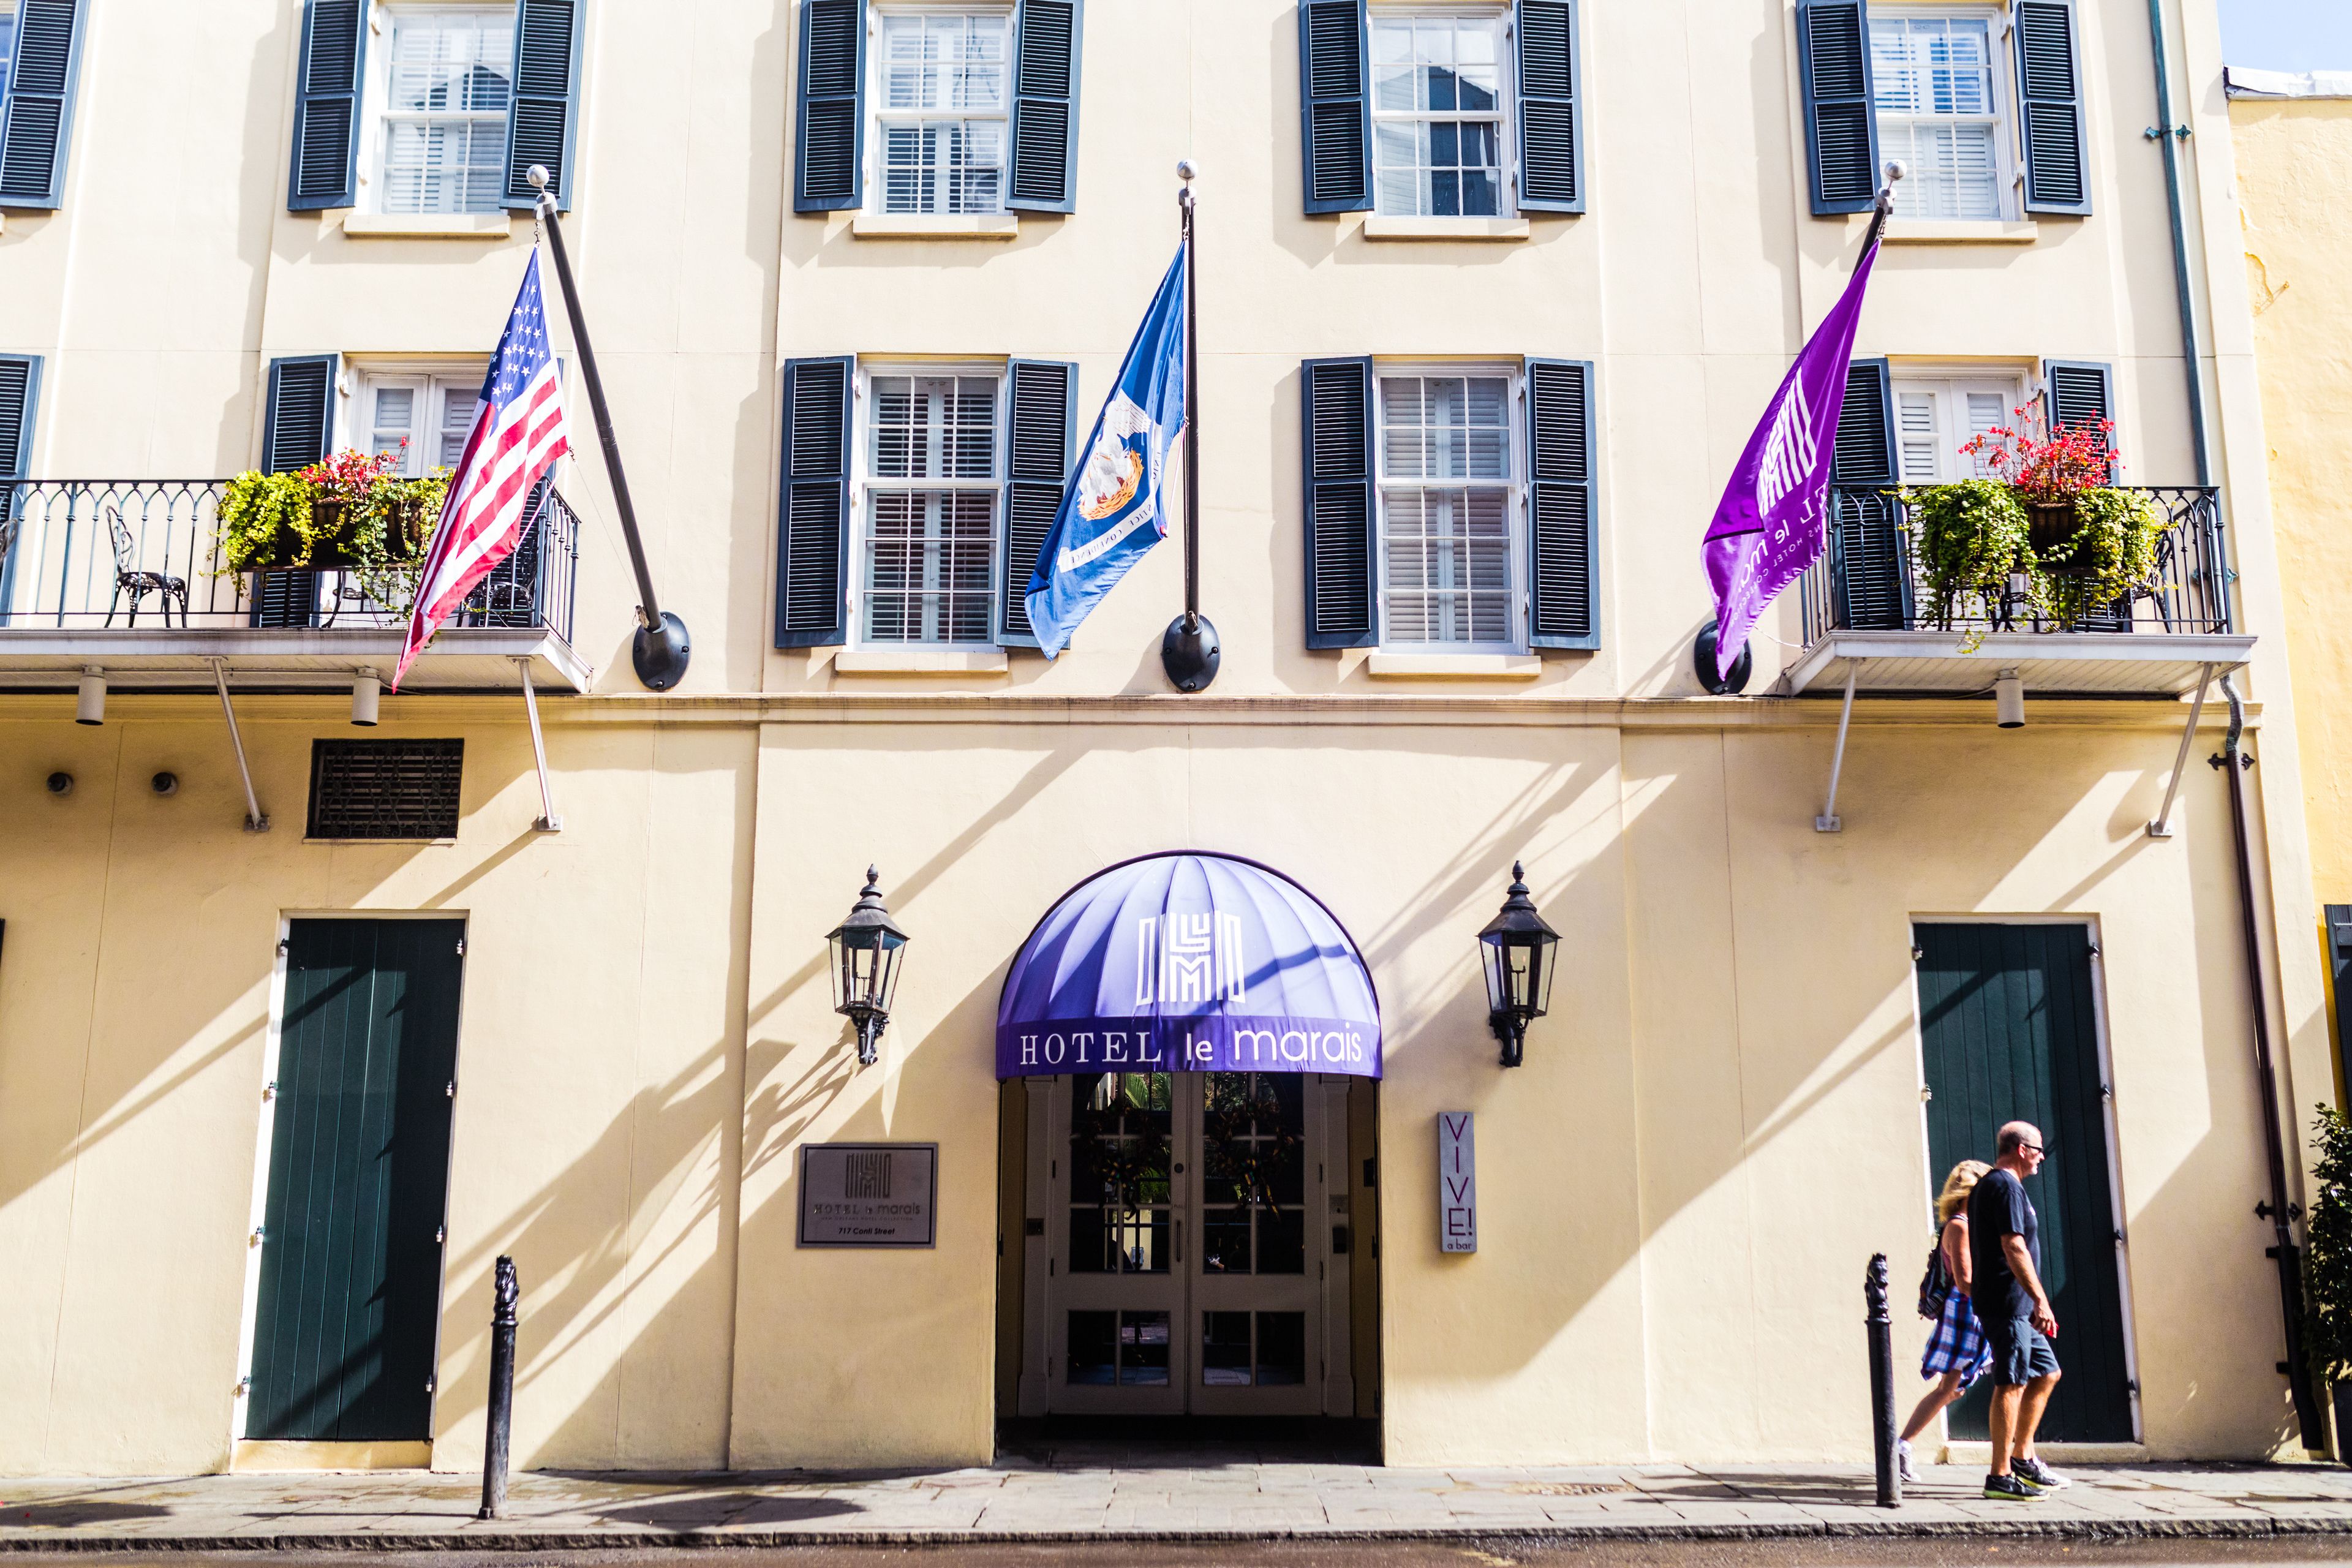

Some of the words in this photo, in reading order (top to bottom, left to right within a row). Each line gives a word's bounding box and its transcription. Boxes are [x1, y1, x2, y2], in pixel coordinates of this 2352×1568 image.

[1020, 1031, 1161, 1065] HOTEL
[1186, 1033, 1213, 1061] le
[1235, 1022, 1362, 1062] marais
[1446, 1115, 1472, 1236] VIVE!
[814, 1204, 860, 1215] HOTEL
[878, 1202, 920, 1215] marais
[1456, 1238, 1472, 1250] bar
